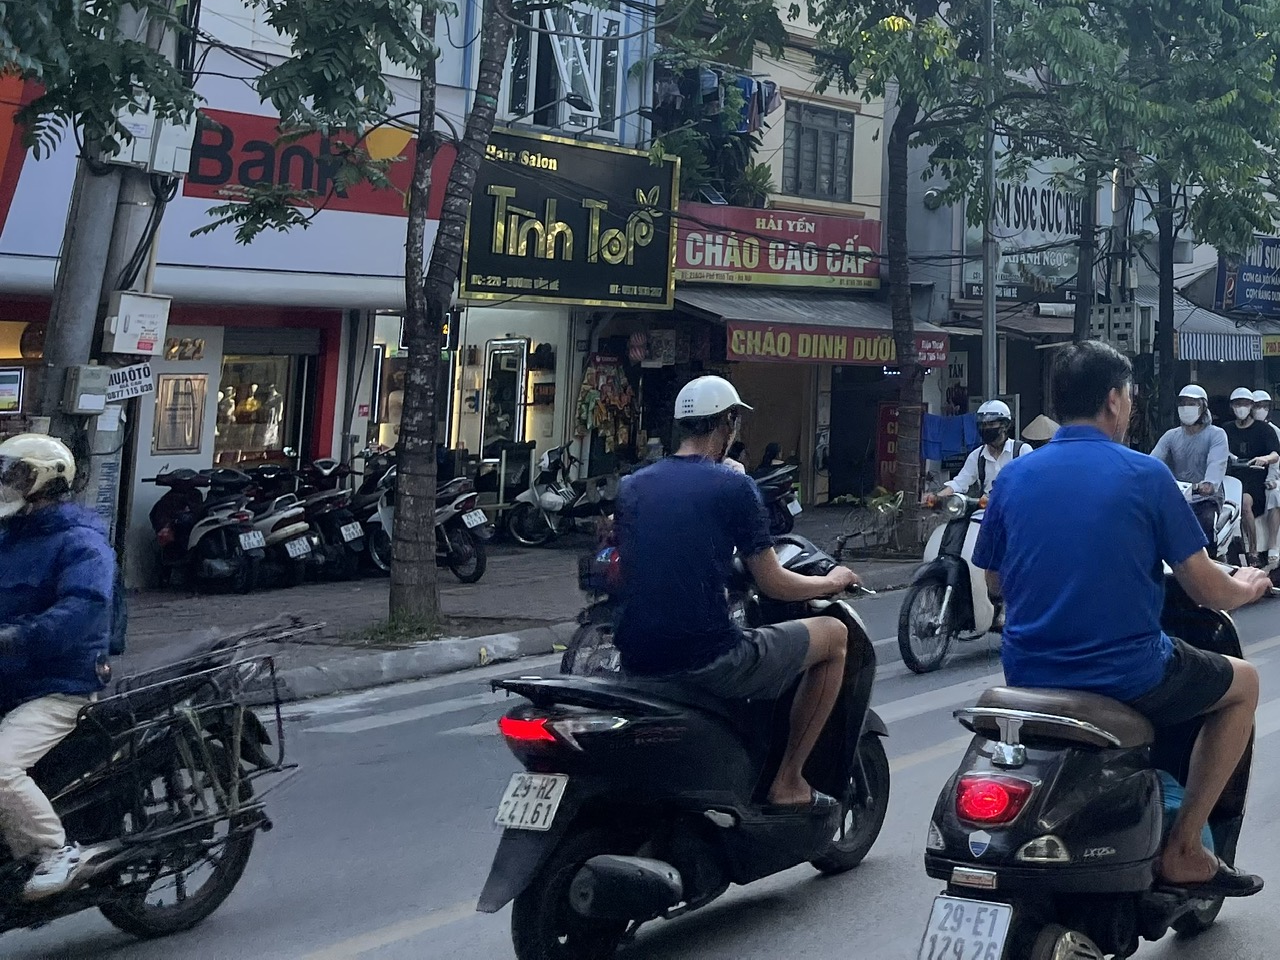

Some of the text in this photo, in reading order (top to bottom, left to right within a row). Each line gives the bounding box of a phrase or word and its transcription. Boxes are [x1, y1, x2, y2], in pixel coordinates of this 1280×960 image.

[521, 149, 558, 171] Salon
[768, 240, 819, 272] CAO
[731, 326, 792, 358] CHÁO
[798, 333, 847, 360] DINH
[511, 776, 557, 800] 29-H2
[937, 902, 1000, 938] 29-E1
